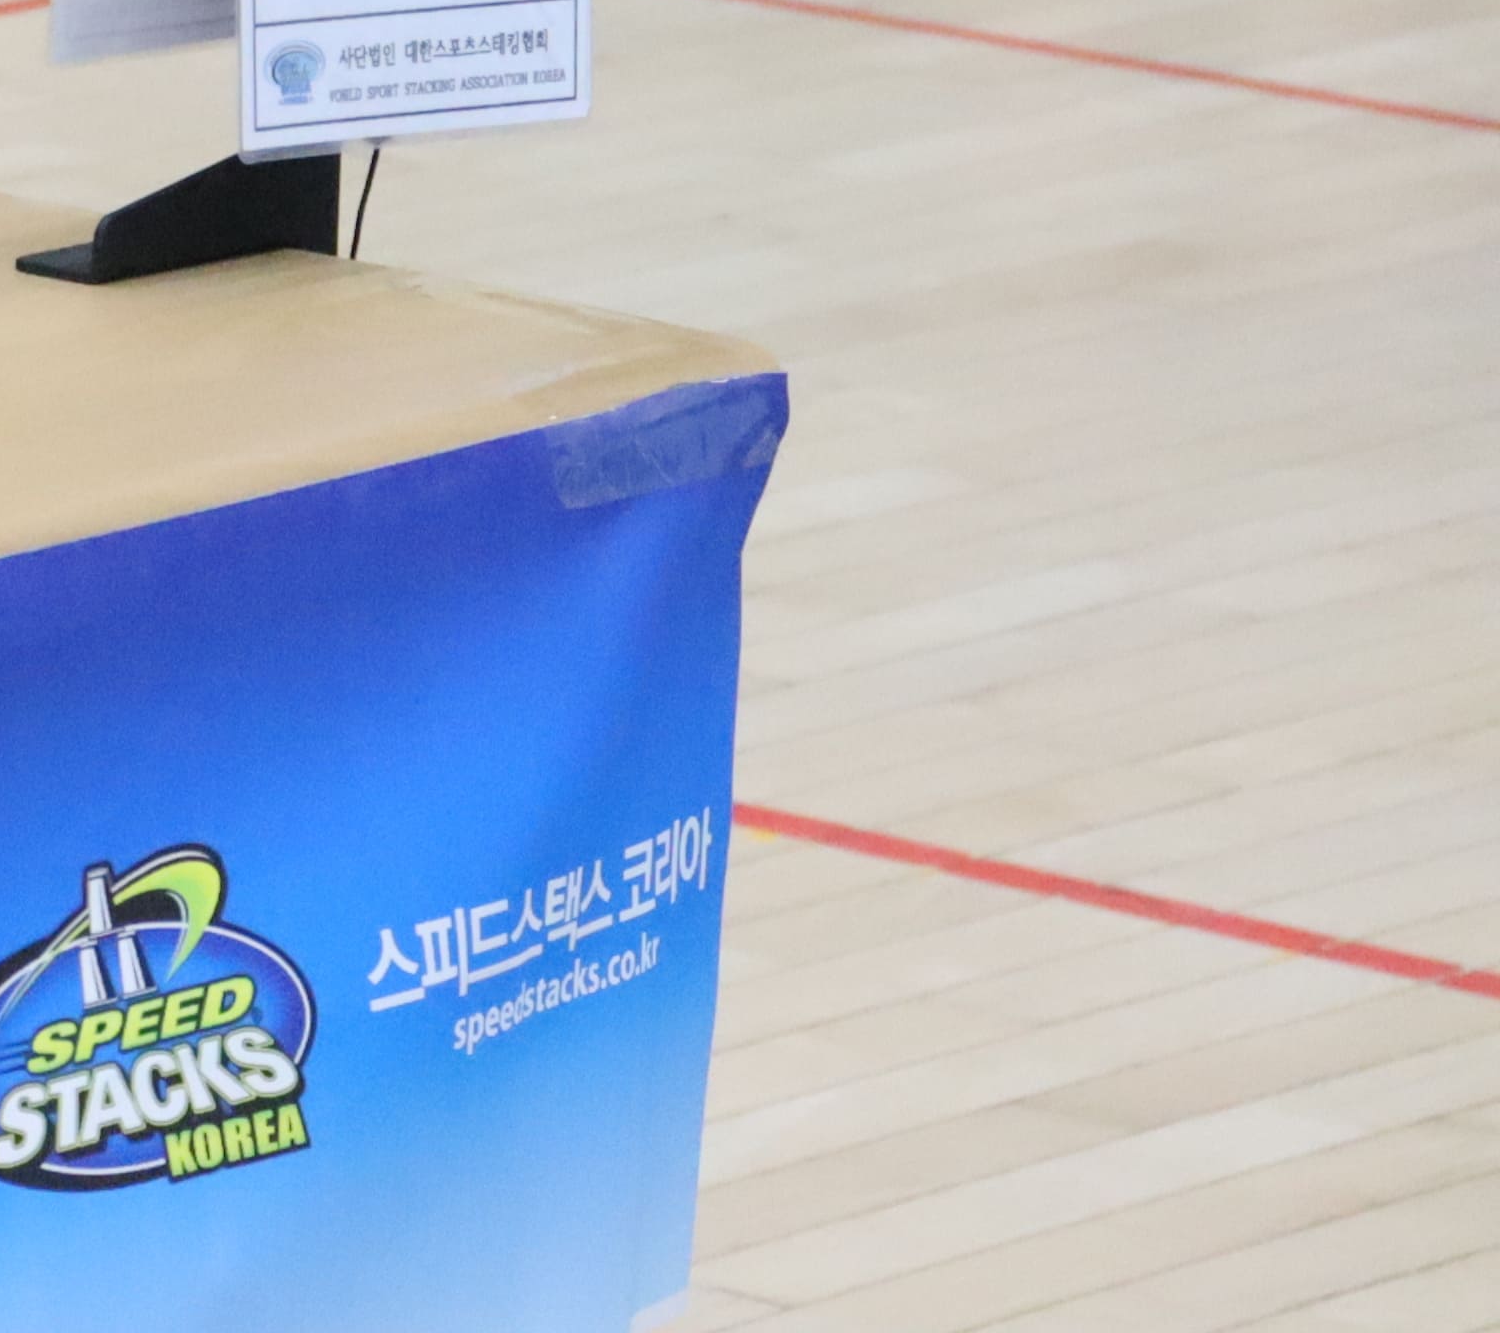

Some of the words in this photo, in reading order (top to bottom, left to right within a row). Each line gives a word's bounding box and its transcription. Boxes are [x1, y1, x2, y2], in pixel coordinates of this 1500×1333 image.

[339, 42, 396, 69] 사단법인
[367, 83, 399, 101] SPORT
[404, 78, 456, 96] STACKING
[460, 72, 529, 92] ASSOCIATION
[533, 68, 567, 85] KOREA
[368, 858, 614, 1013] 스피드스택스
[619, 805, 713, 923] 코리아
[26, 974, 256, 1074] SPEED
[453, 931, 660, 1056] speedstacks.co.kr
[164, 1103, 308, 1178] KOREA
